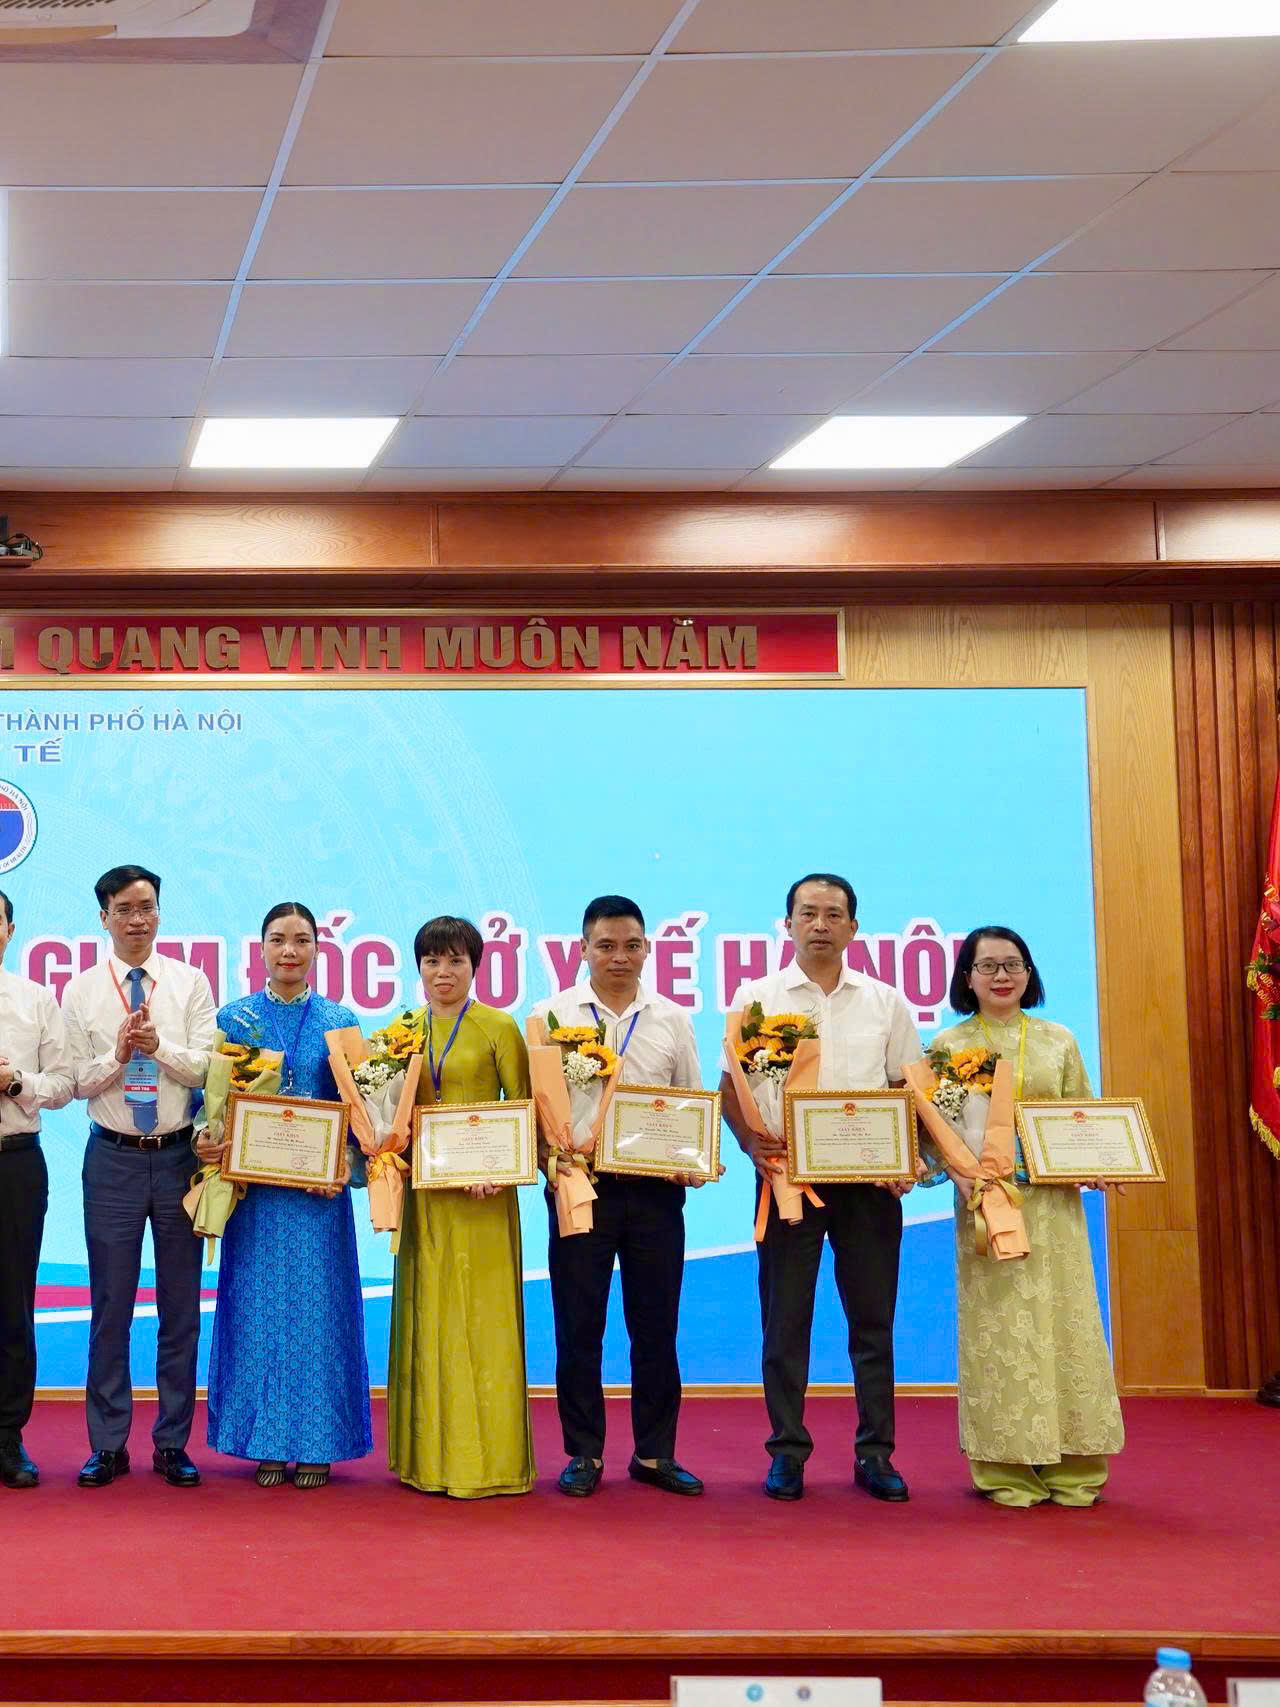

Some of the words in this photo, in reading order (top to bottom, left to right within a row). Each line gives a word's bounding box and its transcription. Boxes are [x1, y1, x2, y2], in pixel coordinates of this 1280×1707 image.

[37, 626, 241, 674] QUANG
[261, 626, 402, 669] VINH
[424, 617, 600, 669] MUÔN
[622, 616, 758, 669] NĂM
[90, 706, 145, 731] PHỐ
[153, 709, 188, 731] HÀ
[199, 709, 242, 734] NỘI
[14, 737, 63, 762] TẾ
